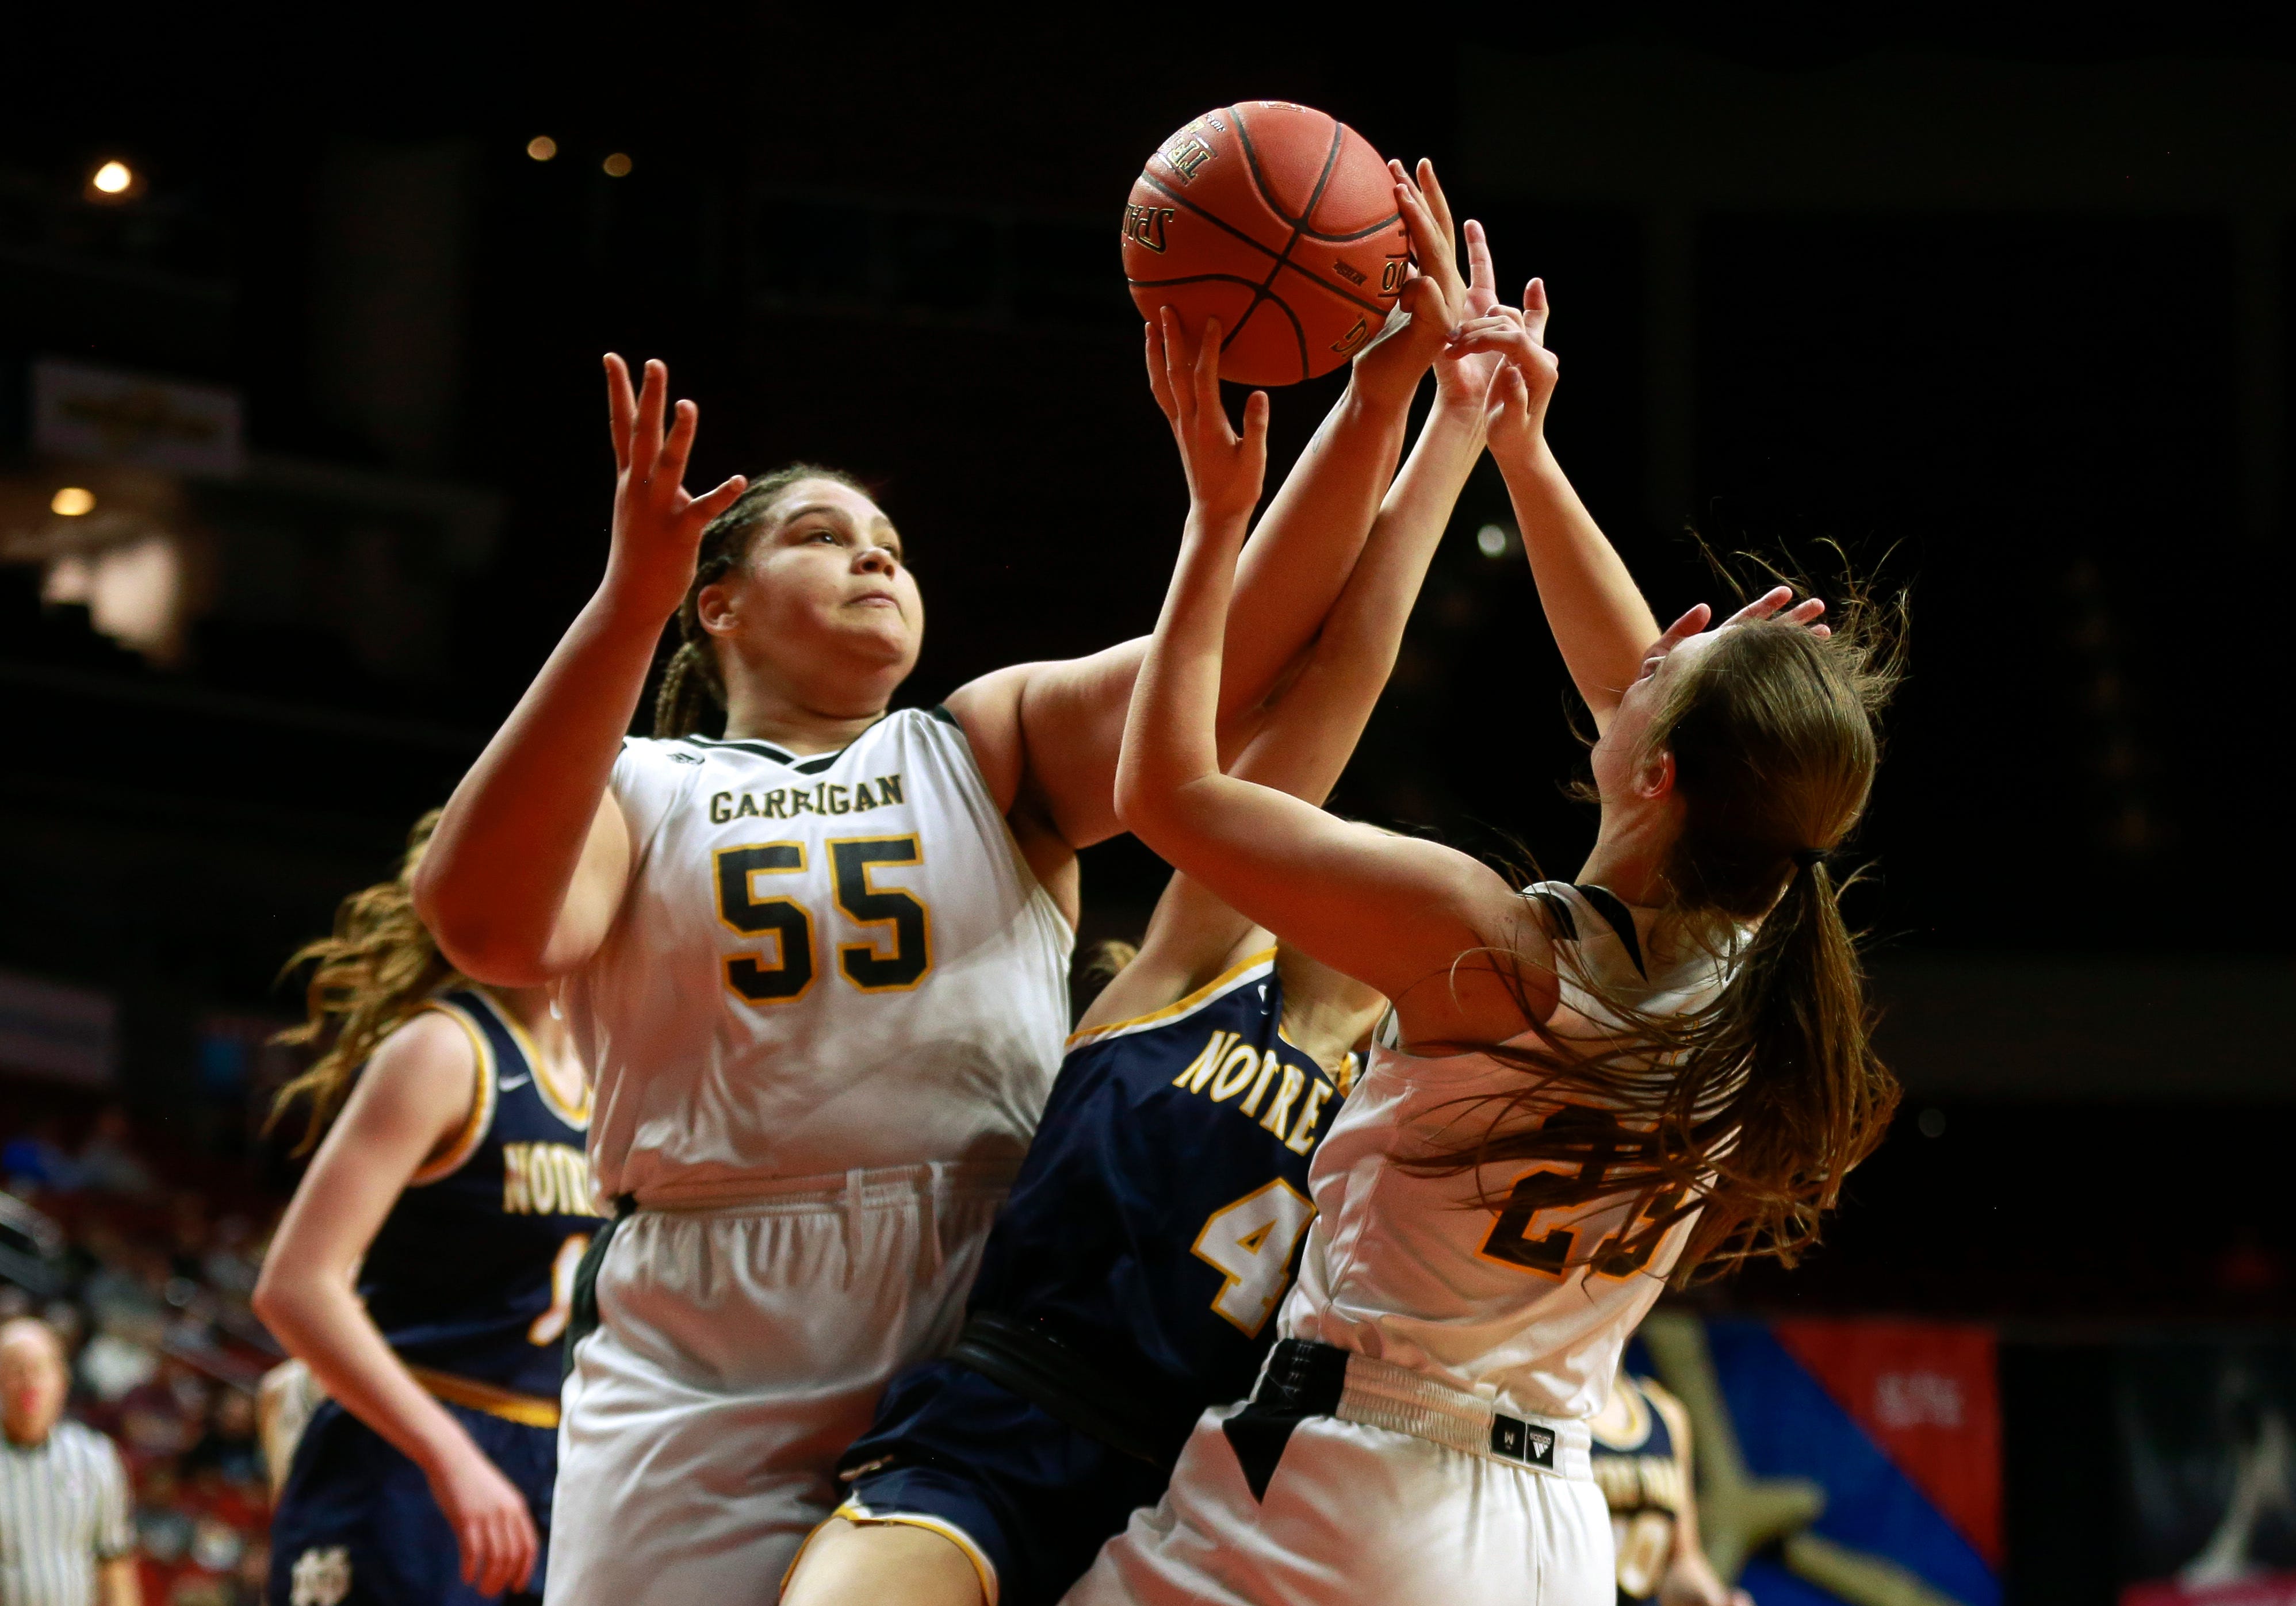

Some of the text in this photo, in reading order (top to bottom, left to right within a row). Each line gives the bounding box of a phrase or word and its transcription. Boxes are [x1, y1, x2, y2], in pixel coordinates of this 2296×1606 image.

[709, 774, 904, 825] GARRIGAN
[711, 833, 934, 1006] 55
[1172, 1030, 1333, 1157] NOTRE
[1189, 1176, 1318, 1340] 4
